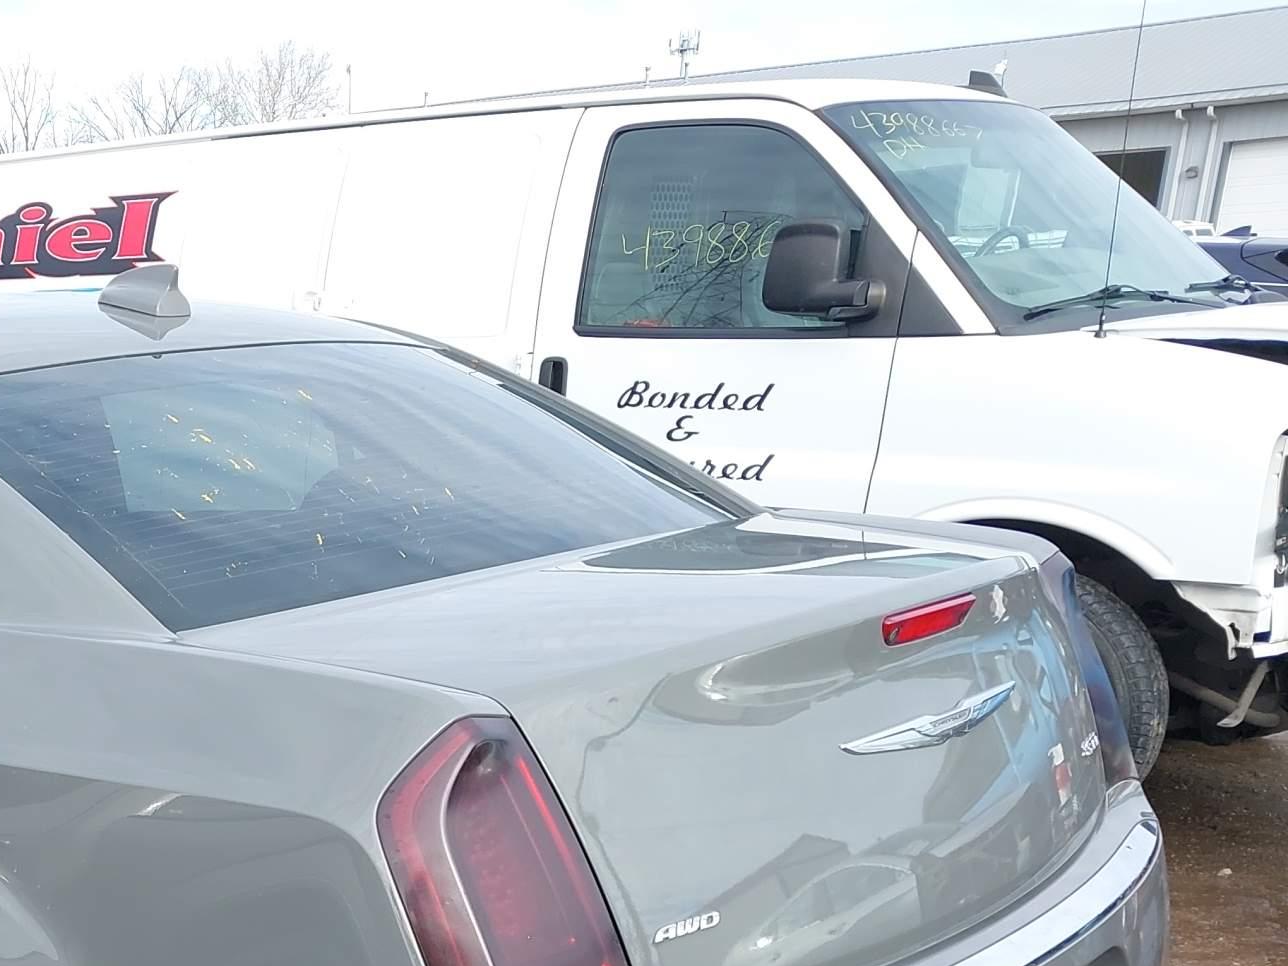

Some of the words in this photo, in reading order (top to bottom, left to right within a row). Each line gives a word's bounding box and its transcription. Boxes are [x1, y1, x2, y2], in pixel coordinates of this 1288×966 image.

[616, 380, 776, 412] Bonded
[665, 414, 700, 442] &
[653, 910, 721, 944] AWD
